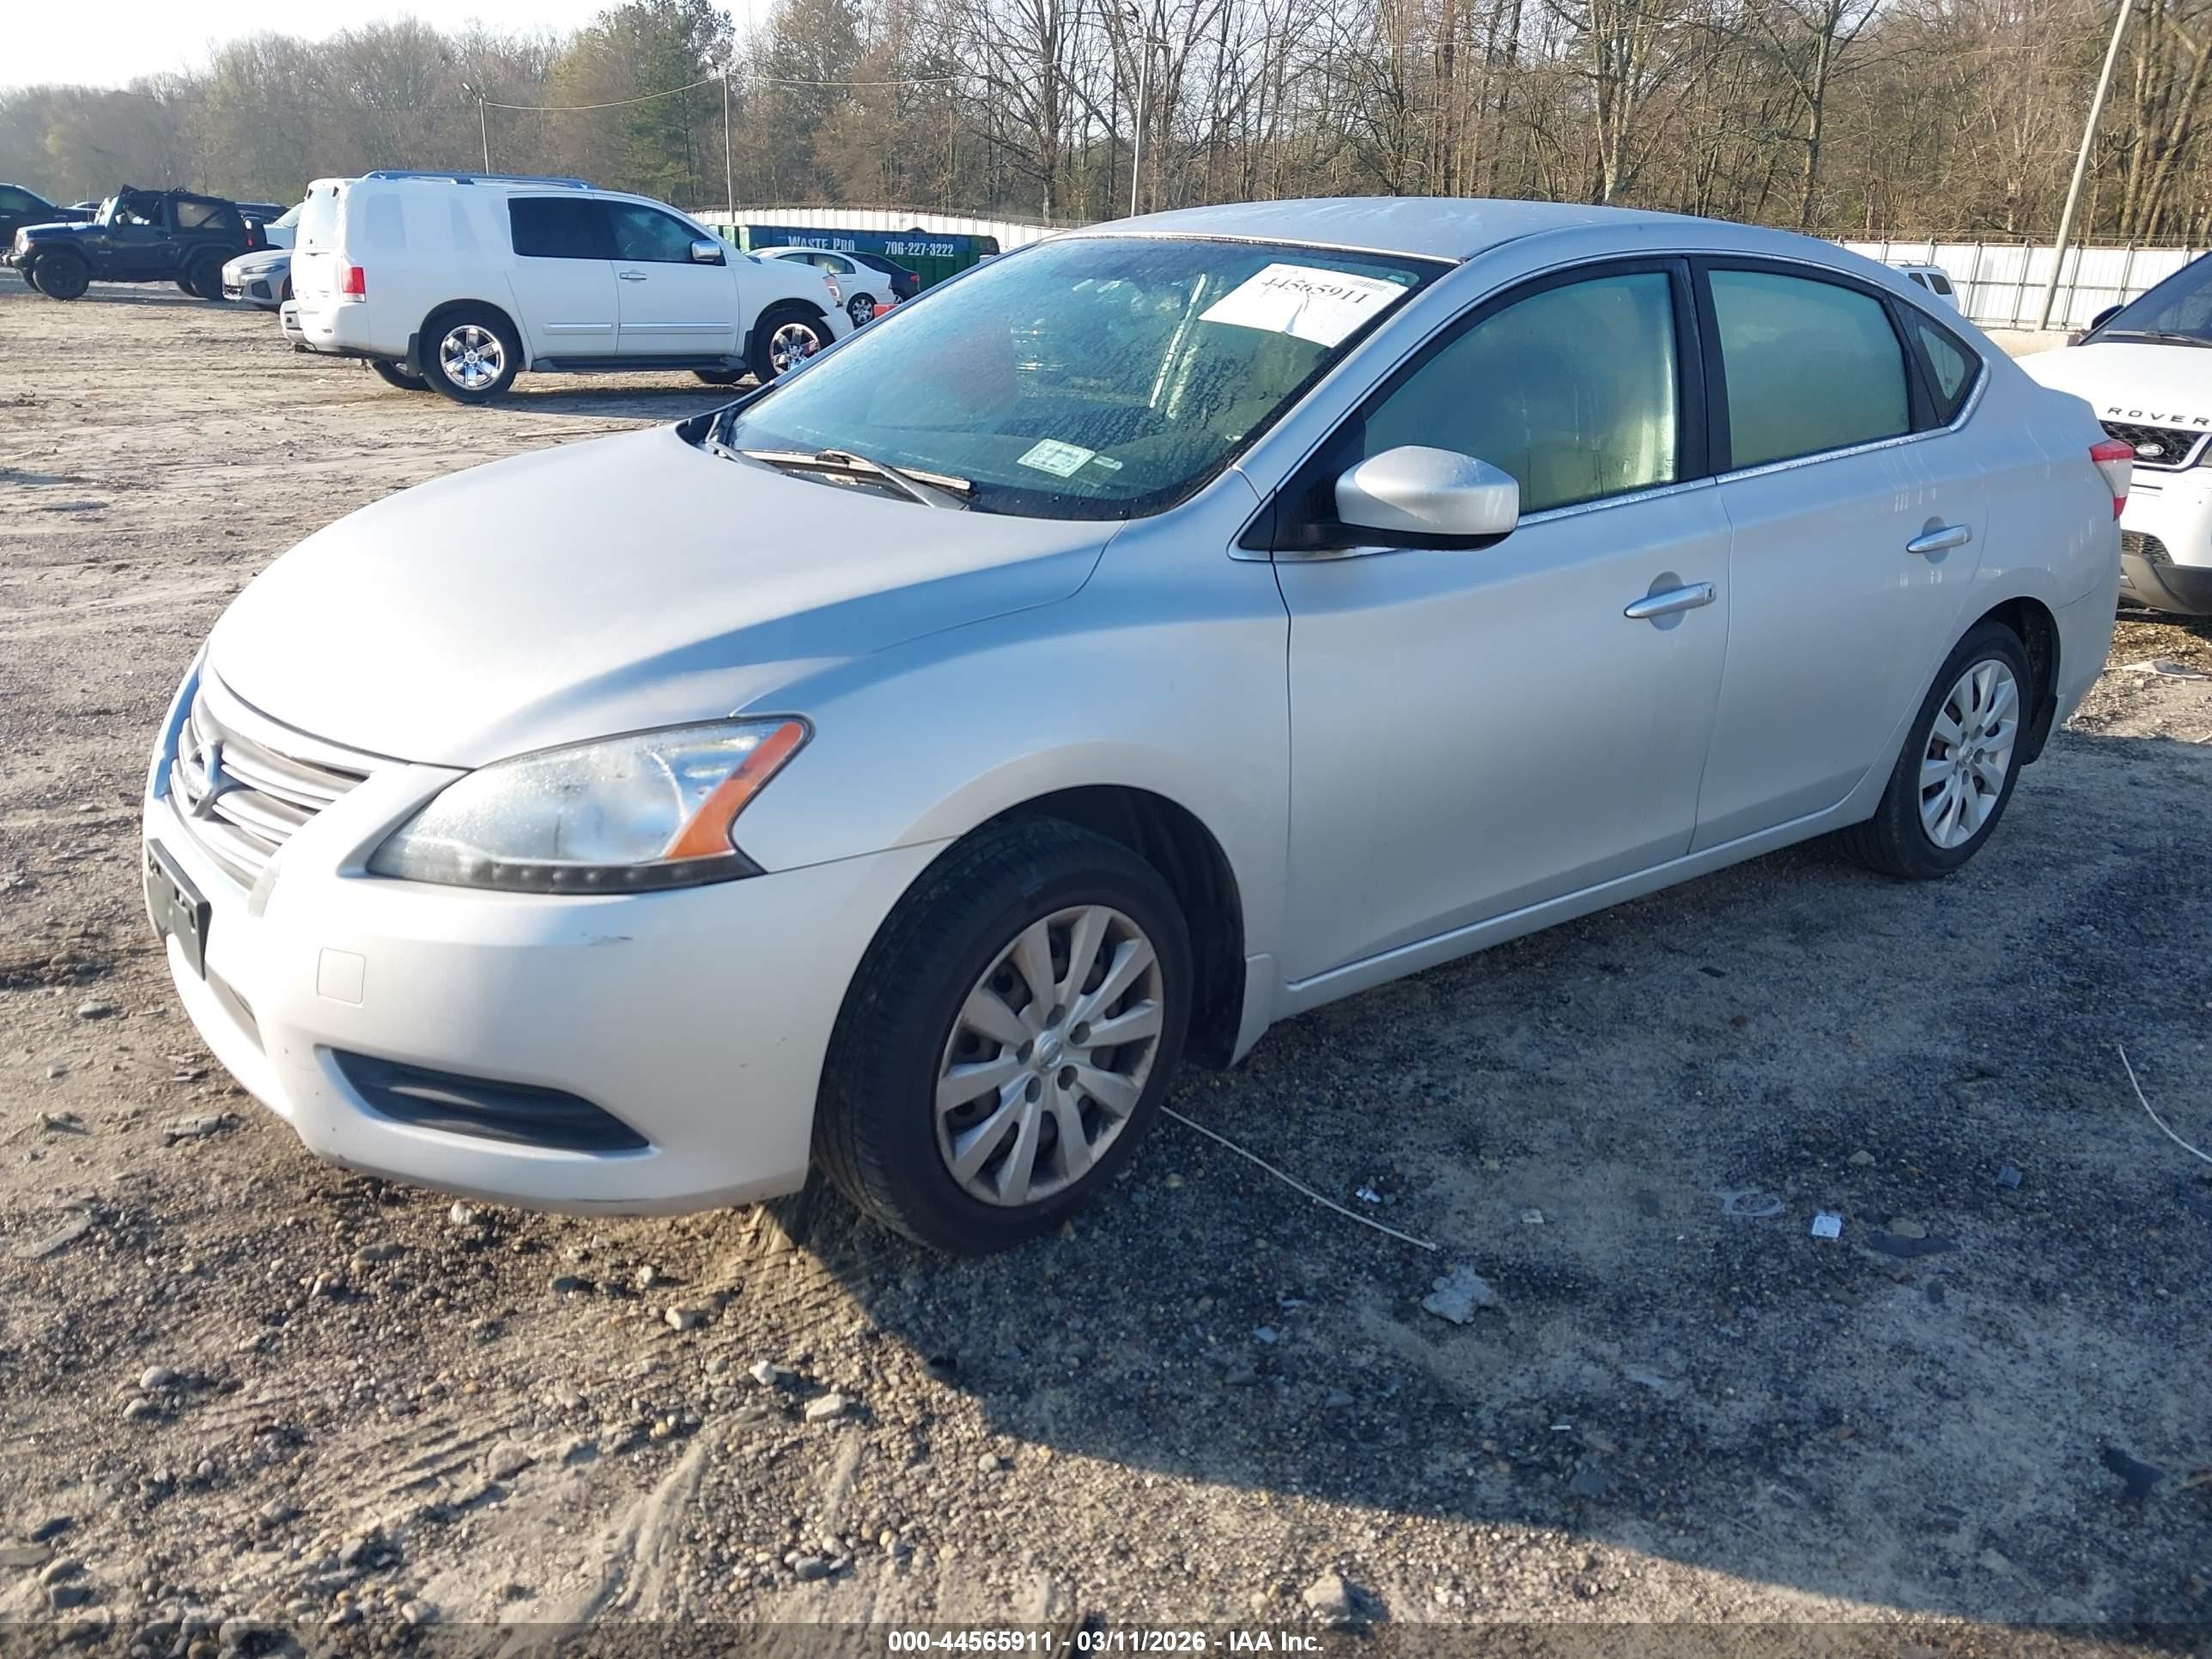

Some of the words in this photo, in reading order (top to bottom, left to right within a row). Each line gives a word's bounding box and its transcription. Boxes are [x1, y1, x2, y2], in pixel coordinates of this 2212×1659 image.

[833, 237, 855, 252] PRO
[884, 240, 954, 257] 706-227-3222
[1261, 276, 1370, 303] 44565911
[2106, 406, 2210, 426] ROVER
